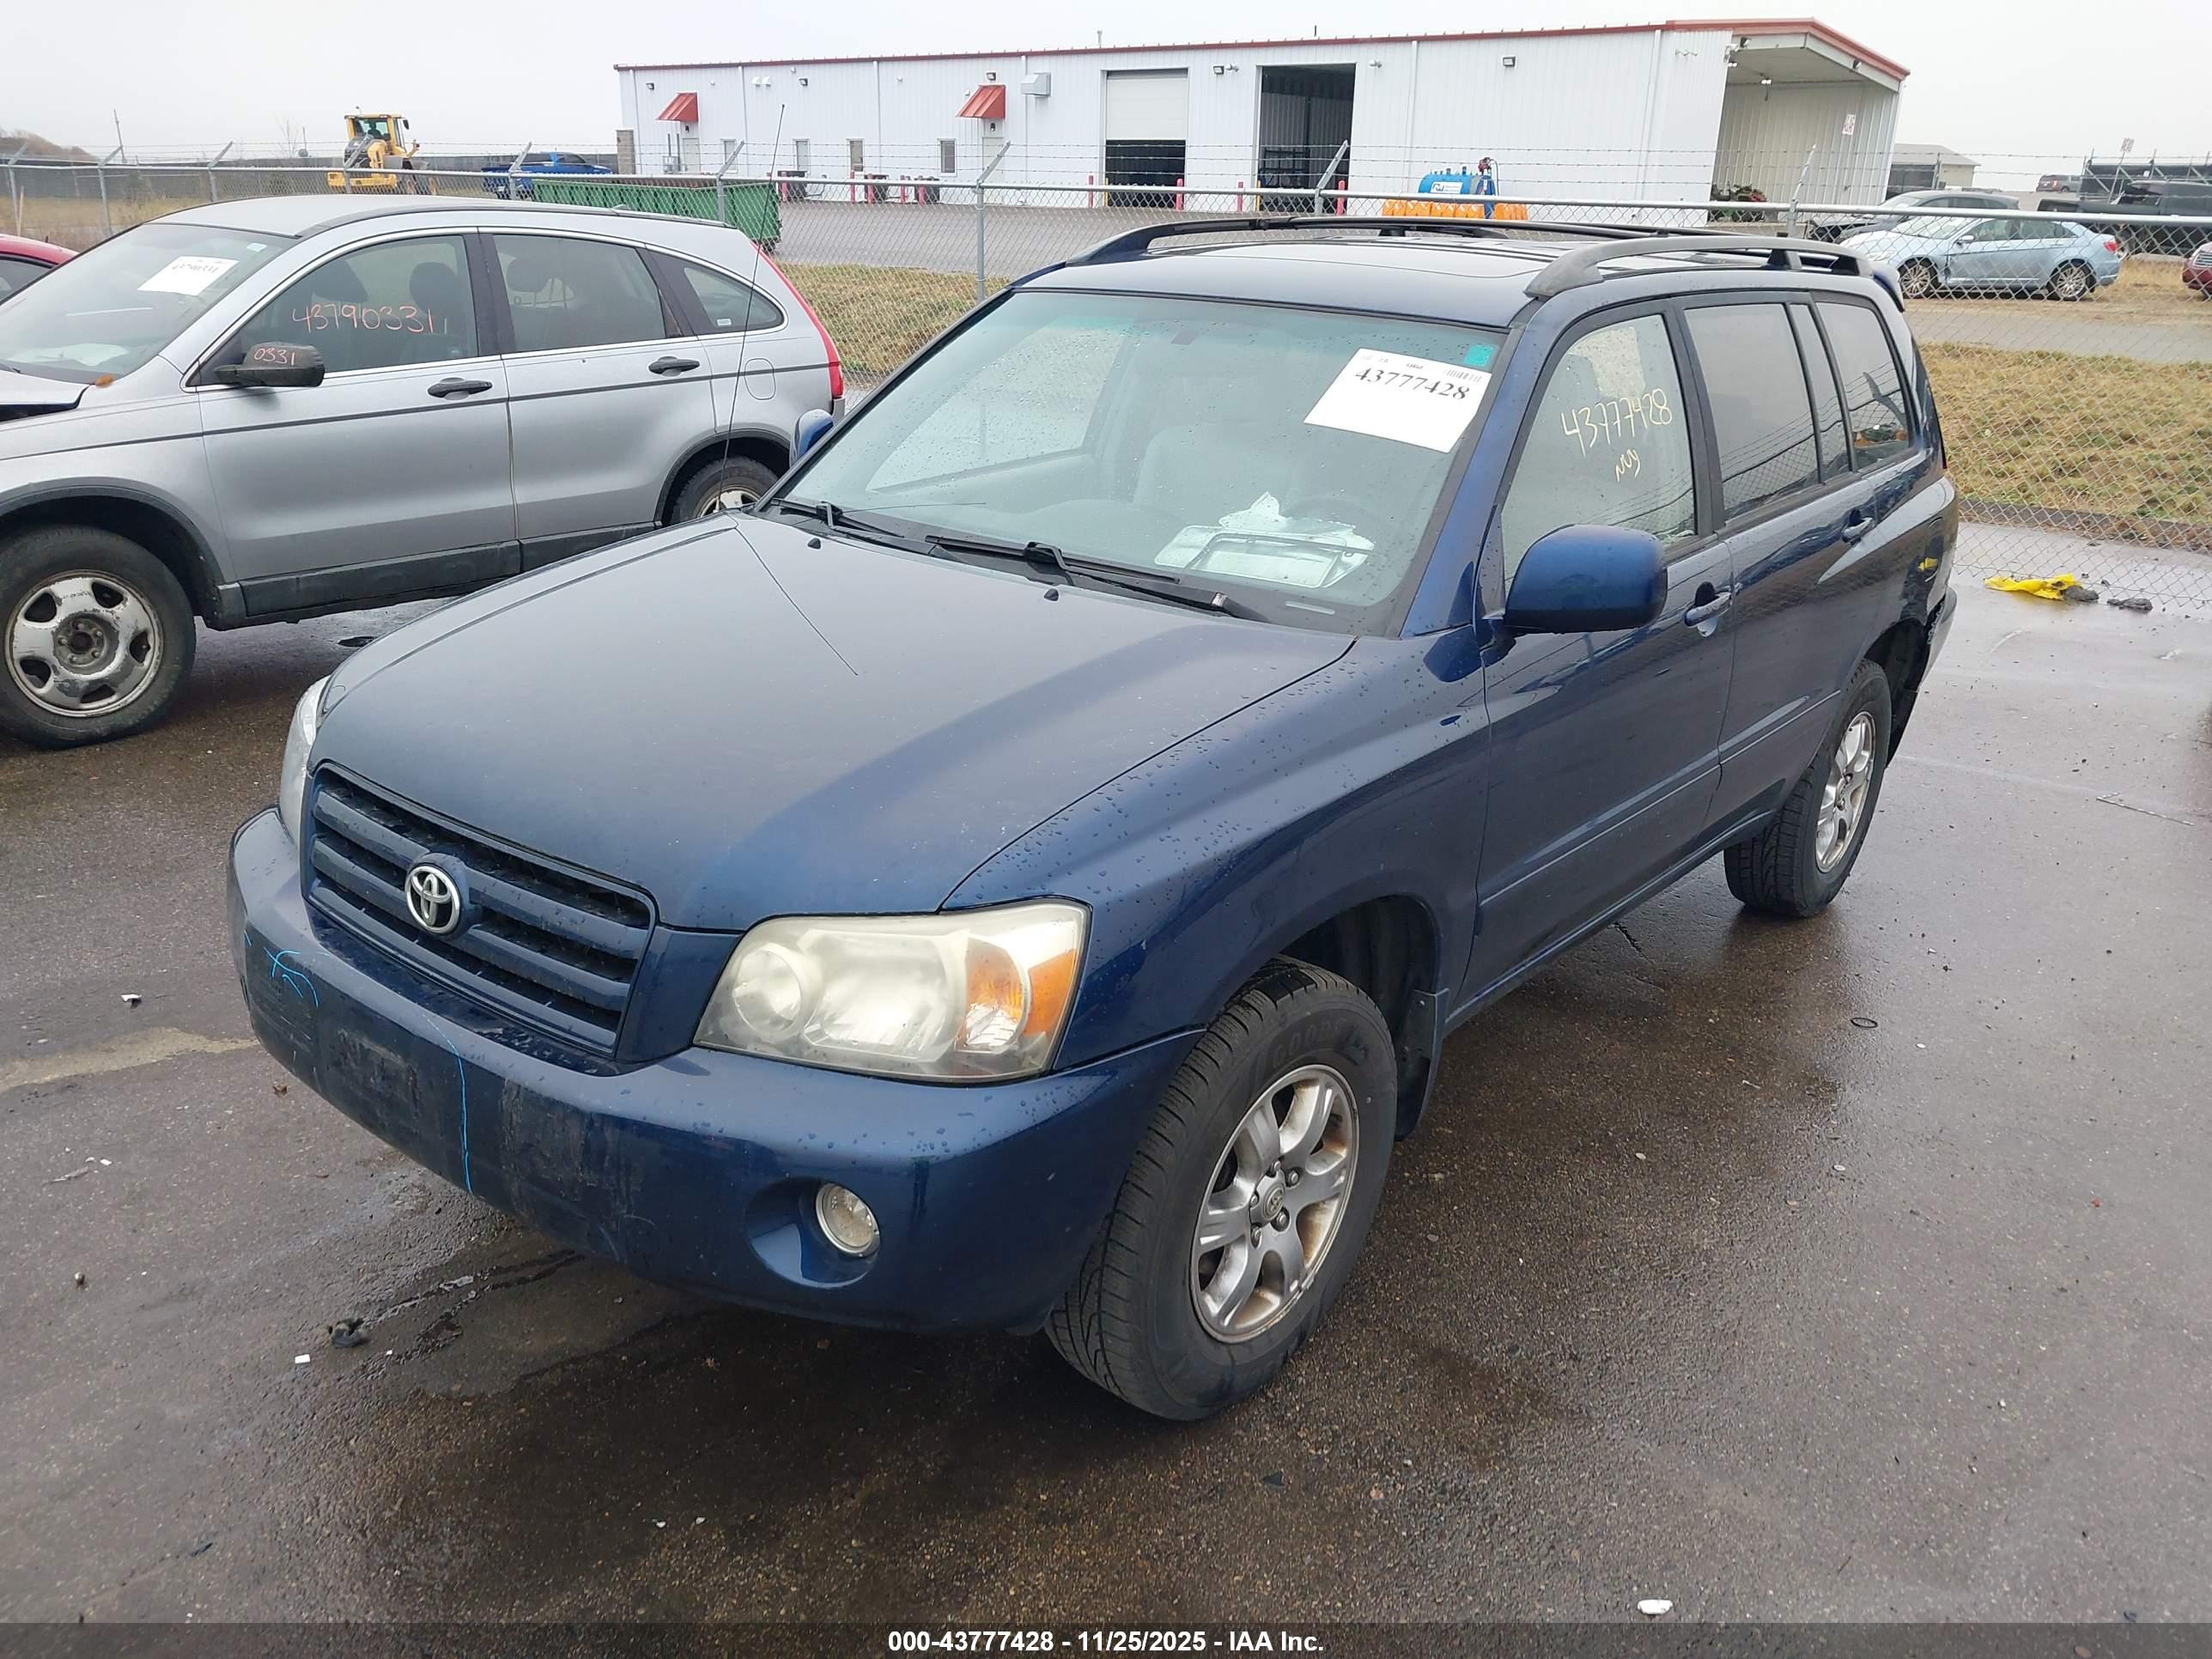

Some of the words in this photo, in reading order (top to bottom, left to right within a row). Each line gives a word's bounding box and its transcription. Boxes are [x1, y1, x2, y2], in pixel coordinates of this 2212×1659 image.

[253, 347, 295, 367] 0331
[1355, 368, 1470, 400] 43777428
[1560, 388, 1673, 458] 43777428
